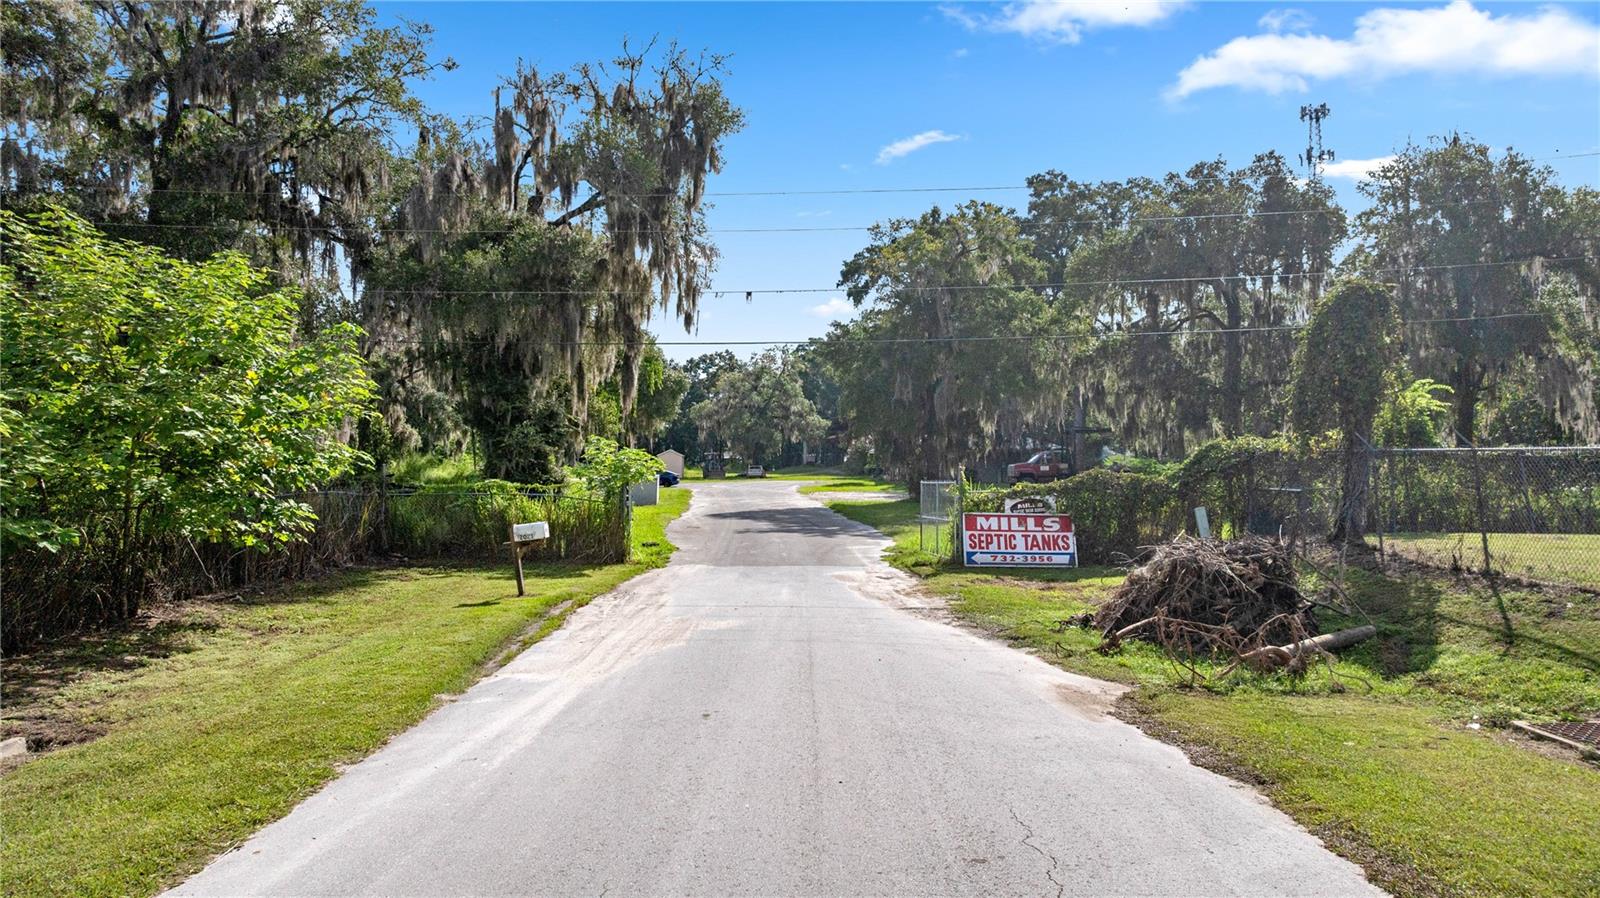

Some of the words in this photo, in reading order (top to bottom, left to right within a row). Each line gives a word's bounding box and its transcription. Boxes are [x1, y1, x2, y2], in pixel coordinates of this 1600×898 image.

[976, 516, 1061, 531] MILLS
[968, 533, 1017, 550] SEPTIC
[1021, 534, 1070, 551] TANKS
